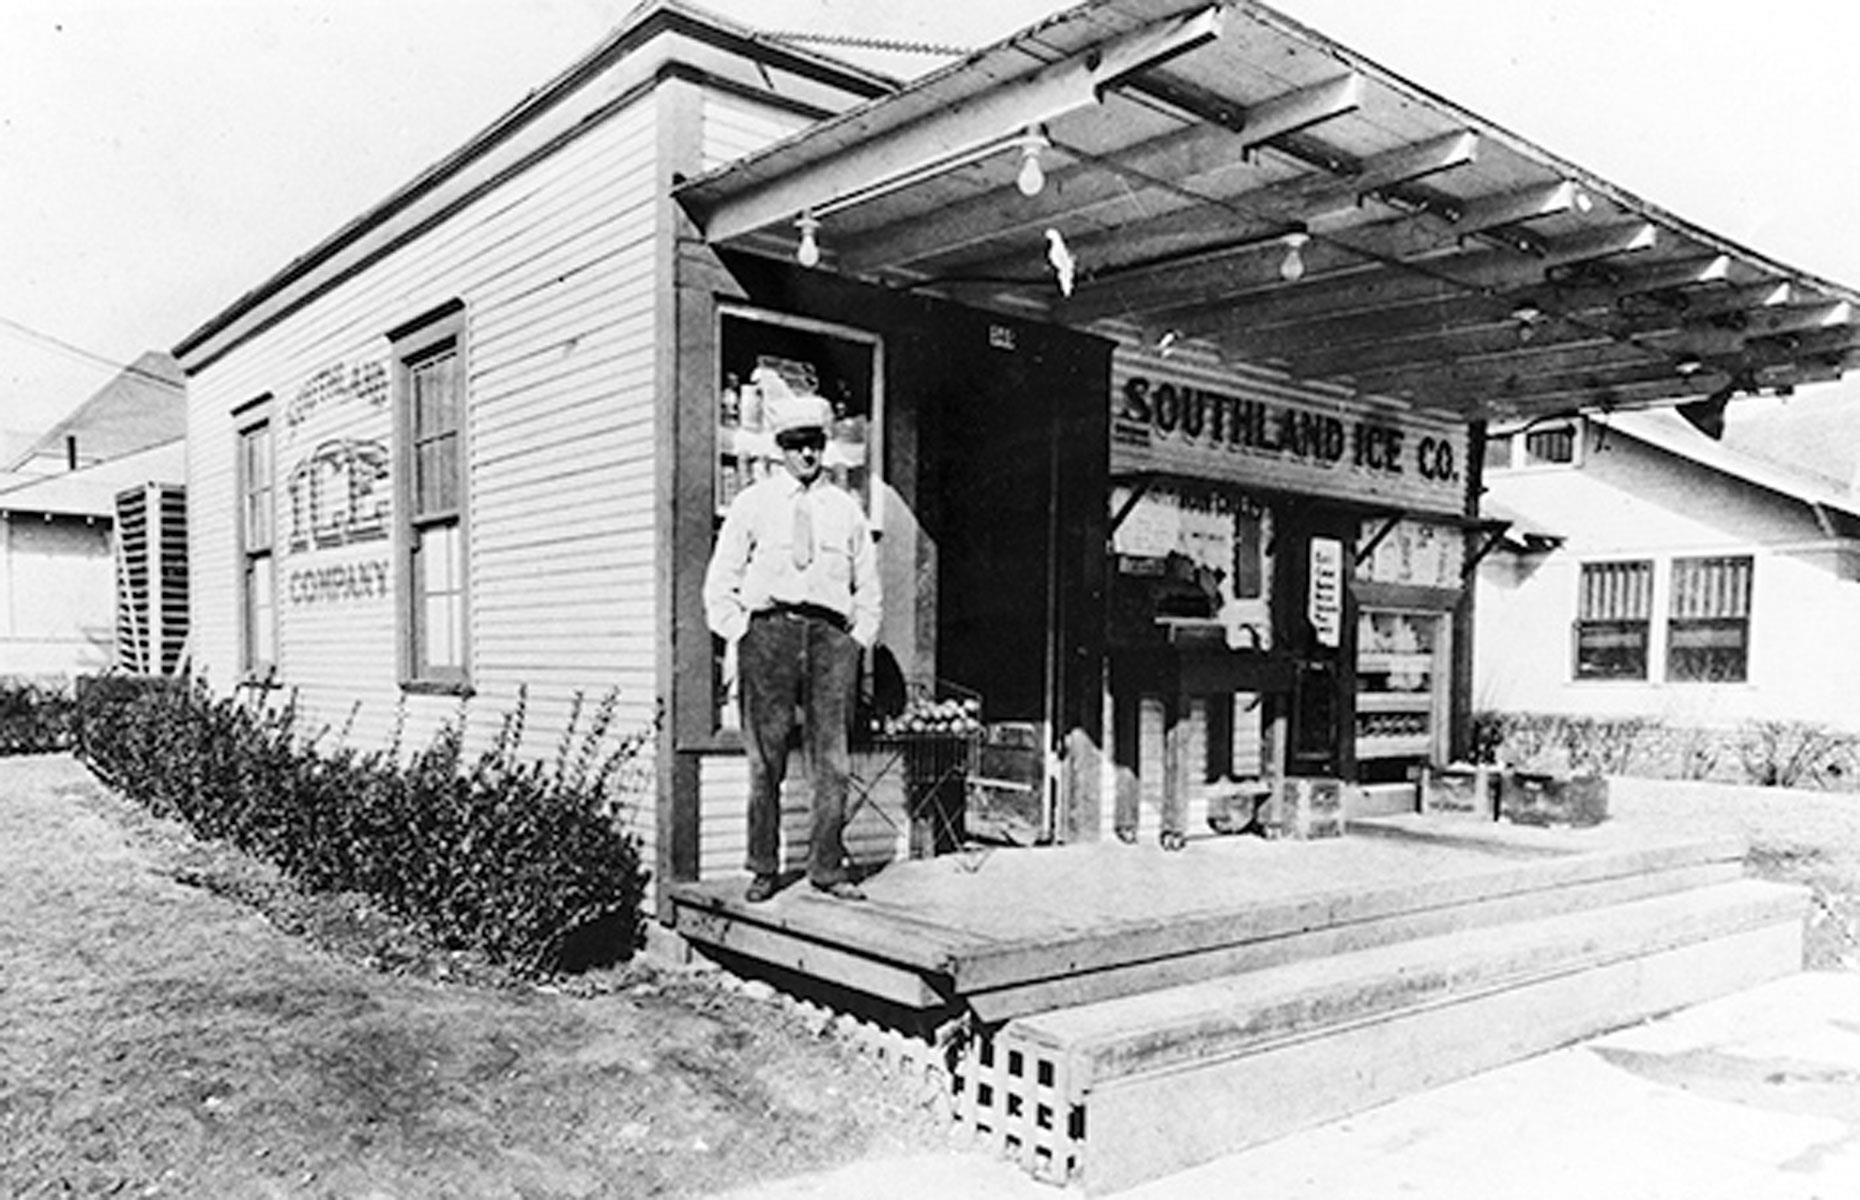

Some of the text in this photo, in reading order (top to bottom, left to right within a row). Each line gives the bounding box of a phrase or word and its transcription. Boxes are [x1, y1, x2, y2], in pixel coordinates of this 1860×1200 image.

[1122, 376, 1345, 464] SOUTHLAND
[1353, 421, 1405, 474] ICE
[1417, 435, 1460, 482] CO.
[287, 439, 390, 552] ICE
[290, 558, 390, 602] COMPANY
